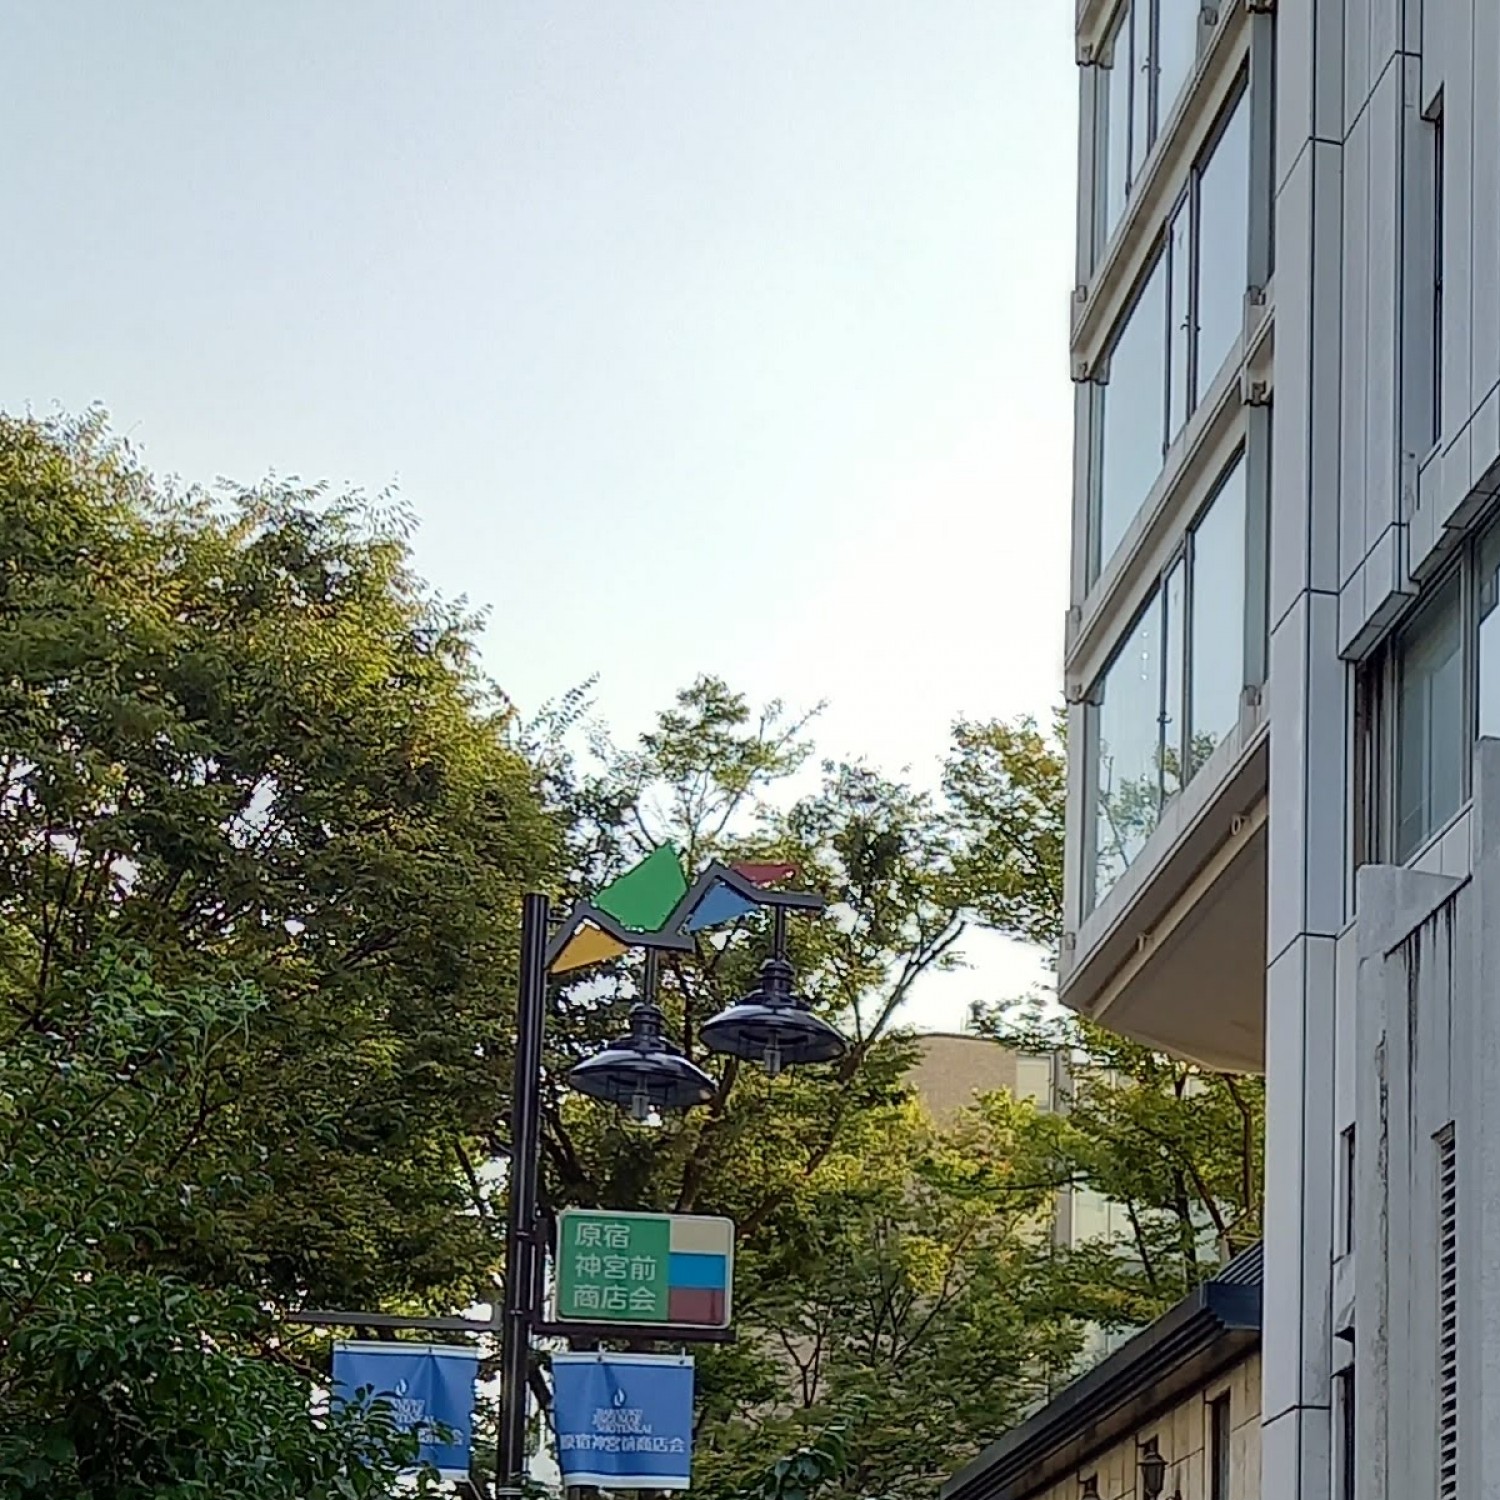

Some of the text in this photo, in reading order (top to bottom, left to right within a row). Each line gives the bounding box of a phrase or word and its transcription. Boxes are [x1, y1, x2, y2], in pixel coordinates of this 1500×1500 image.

[575, 1222, 631, 1249] 原宿
[575, 1253, 657, 1281] 神宮前
[573, 1284, 656, 1311] 商店会
